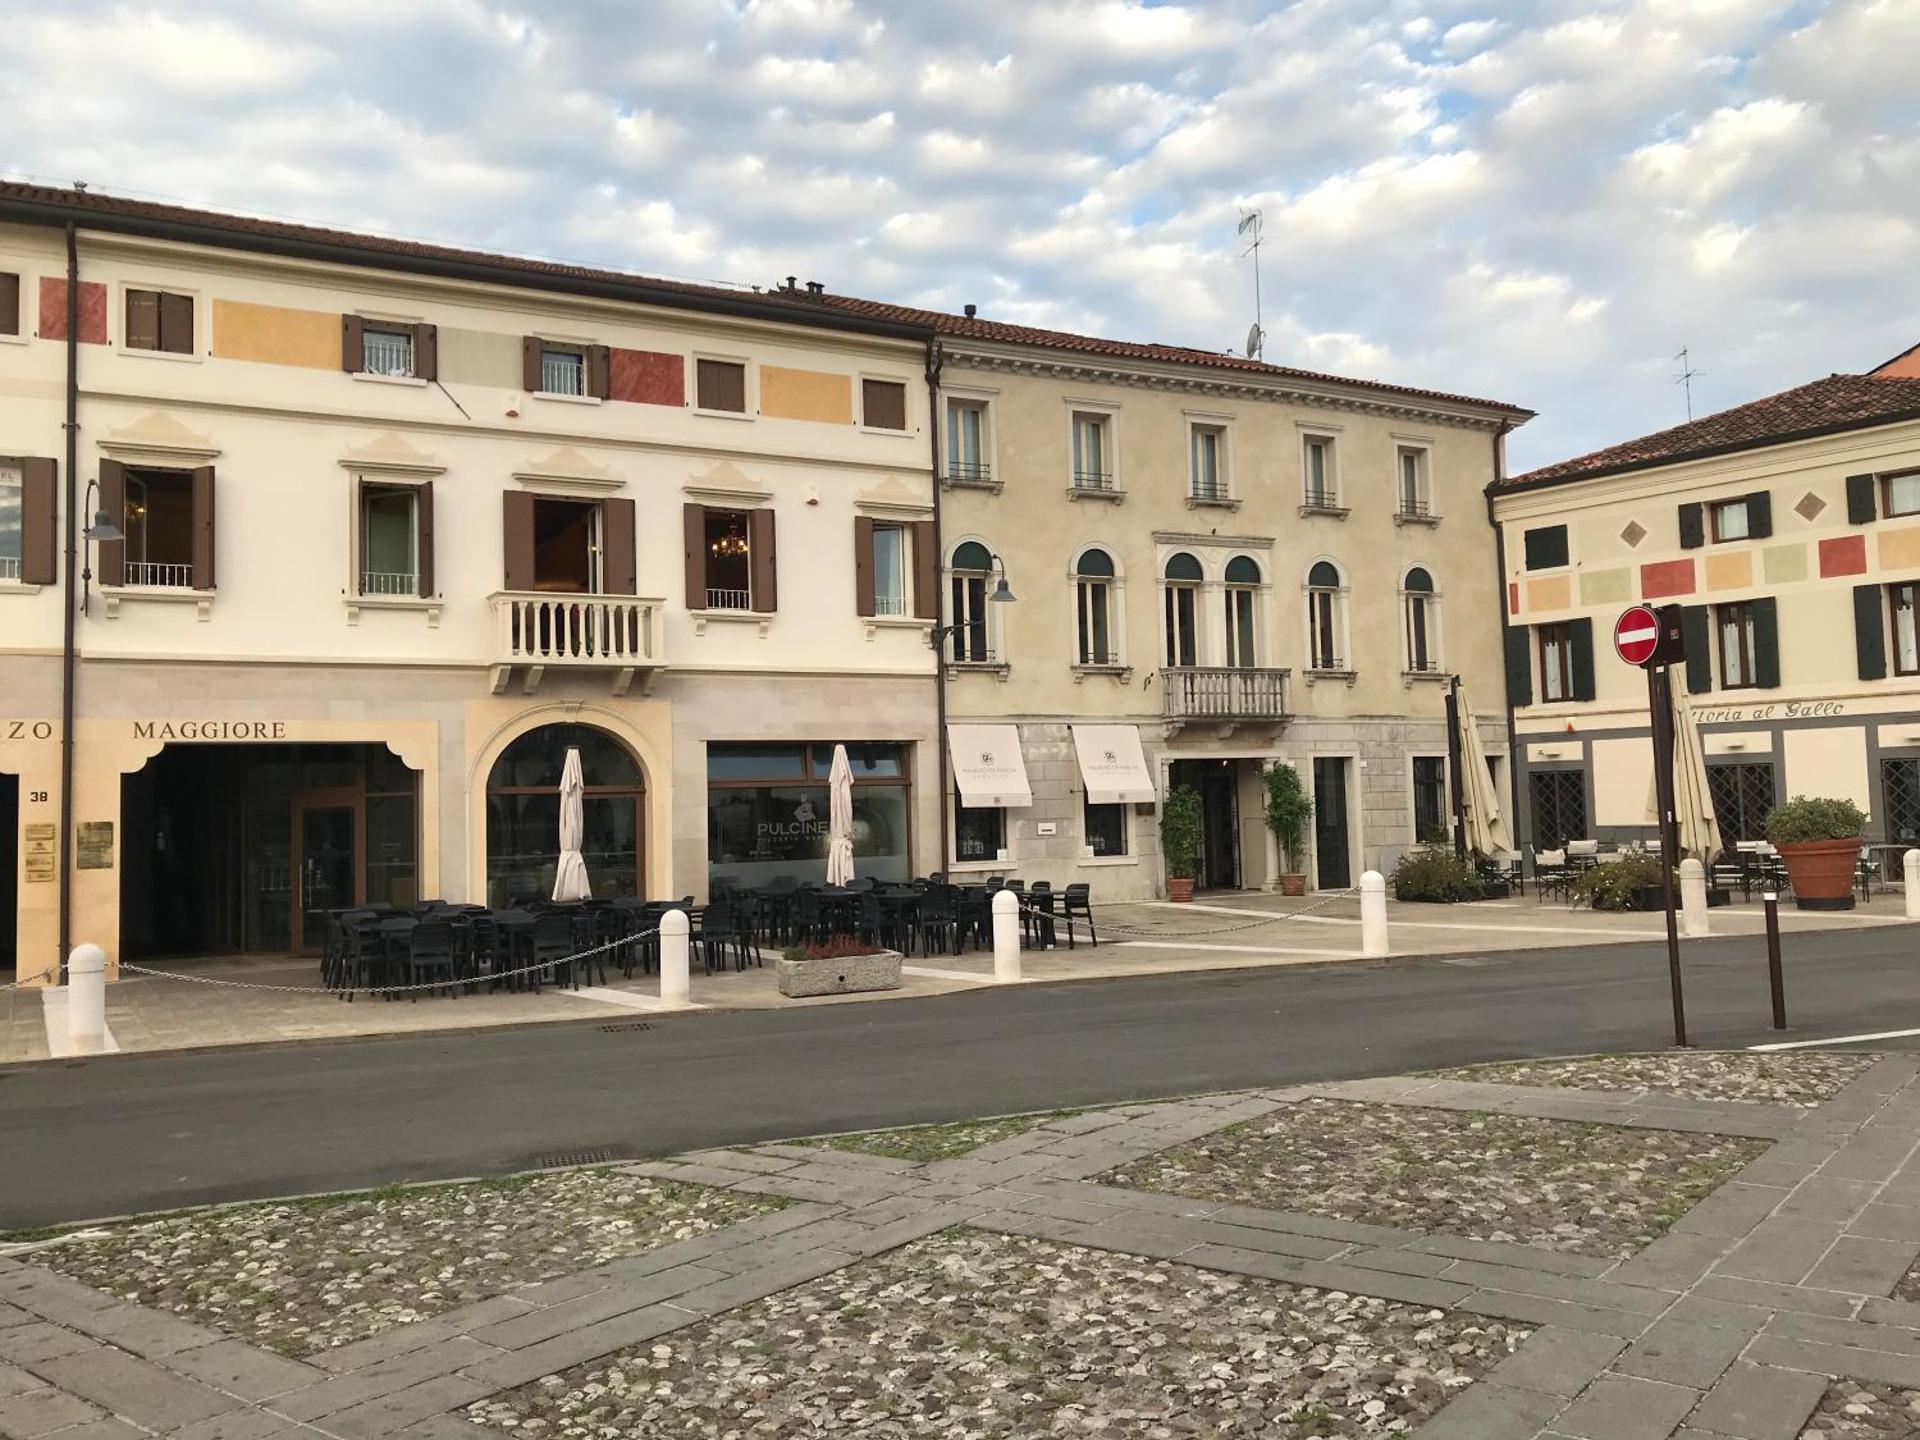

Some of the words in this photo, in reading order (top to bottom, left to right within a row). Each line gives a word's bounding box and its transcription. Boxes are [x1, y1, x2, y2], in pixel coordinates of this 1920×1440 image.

[1753, 705, 1775, 719] al
[1785, 702, 1844, 718] Gallo
[0, 721, 53, 740] ZO
[132, 721, 287, 739] MAGGIORE
[30, 791, 48, 802] 38
[757, 820, 829, 836] PULCINE
